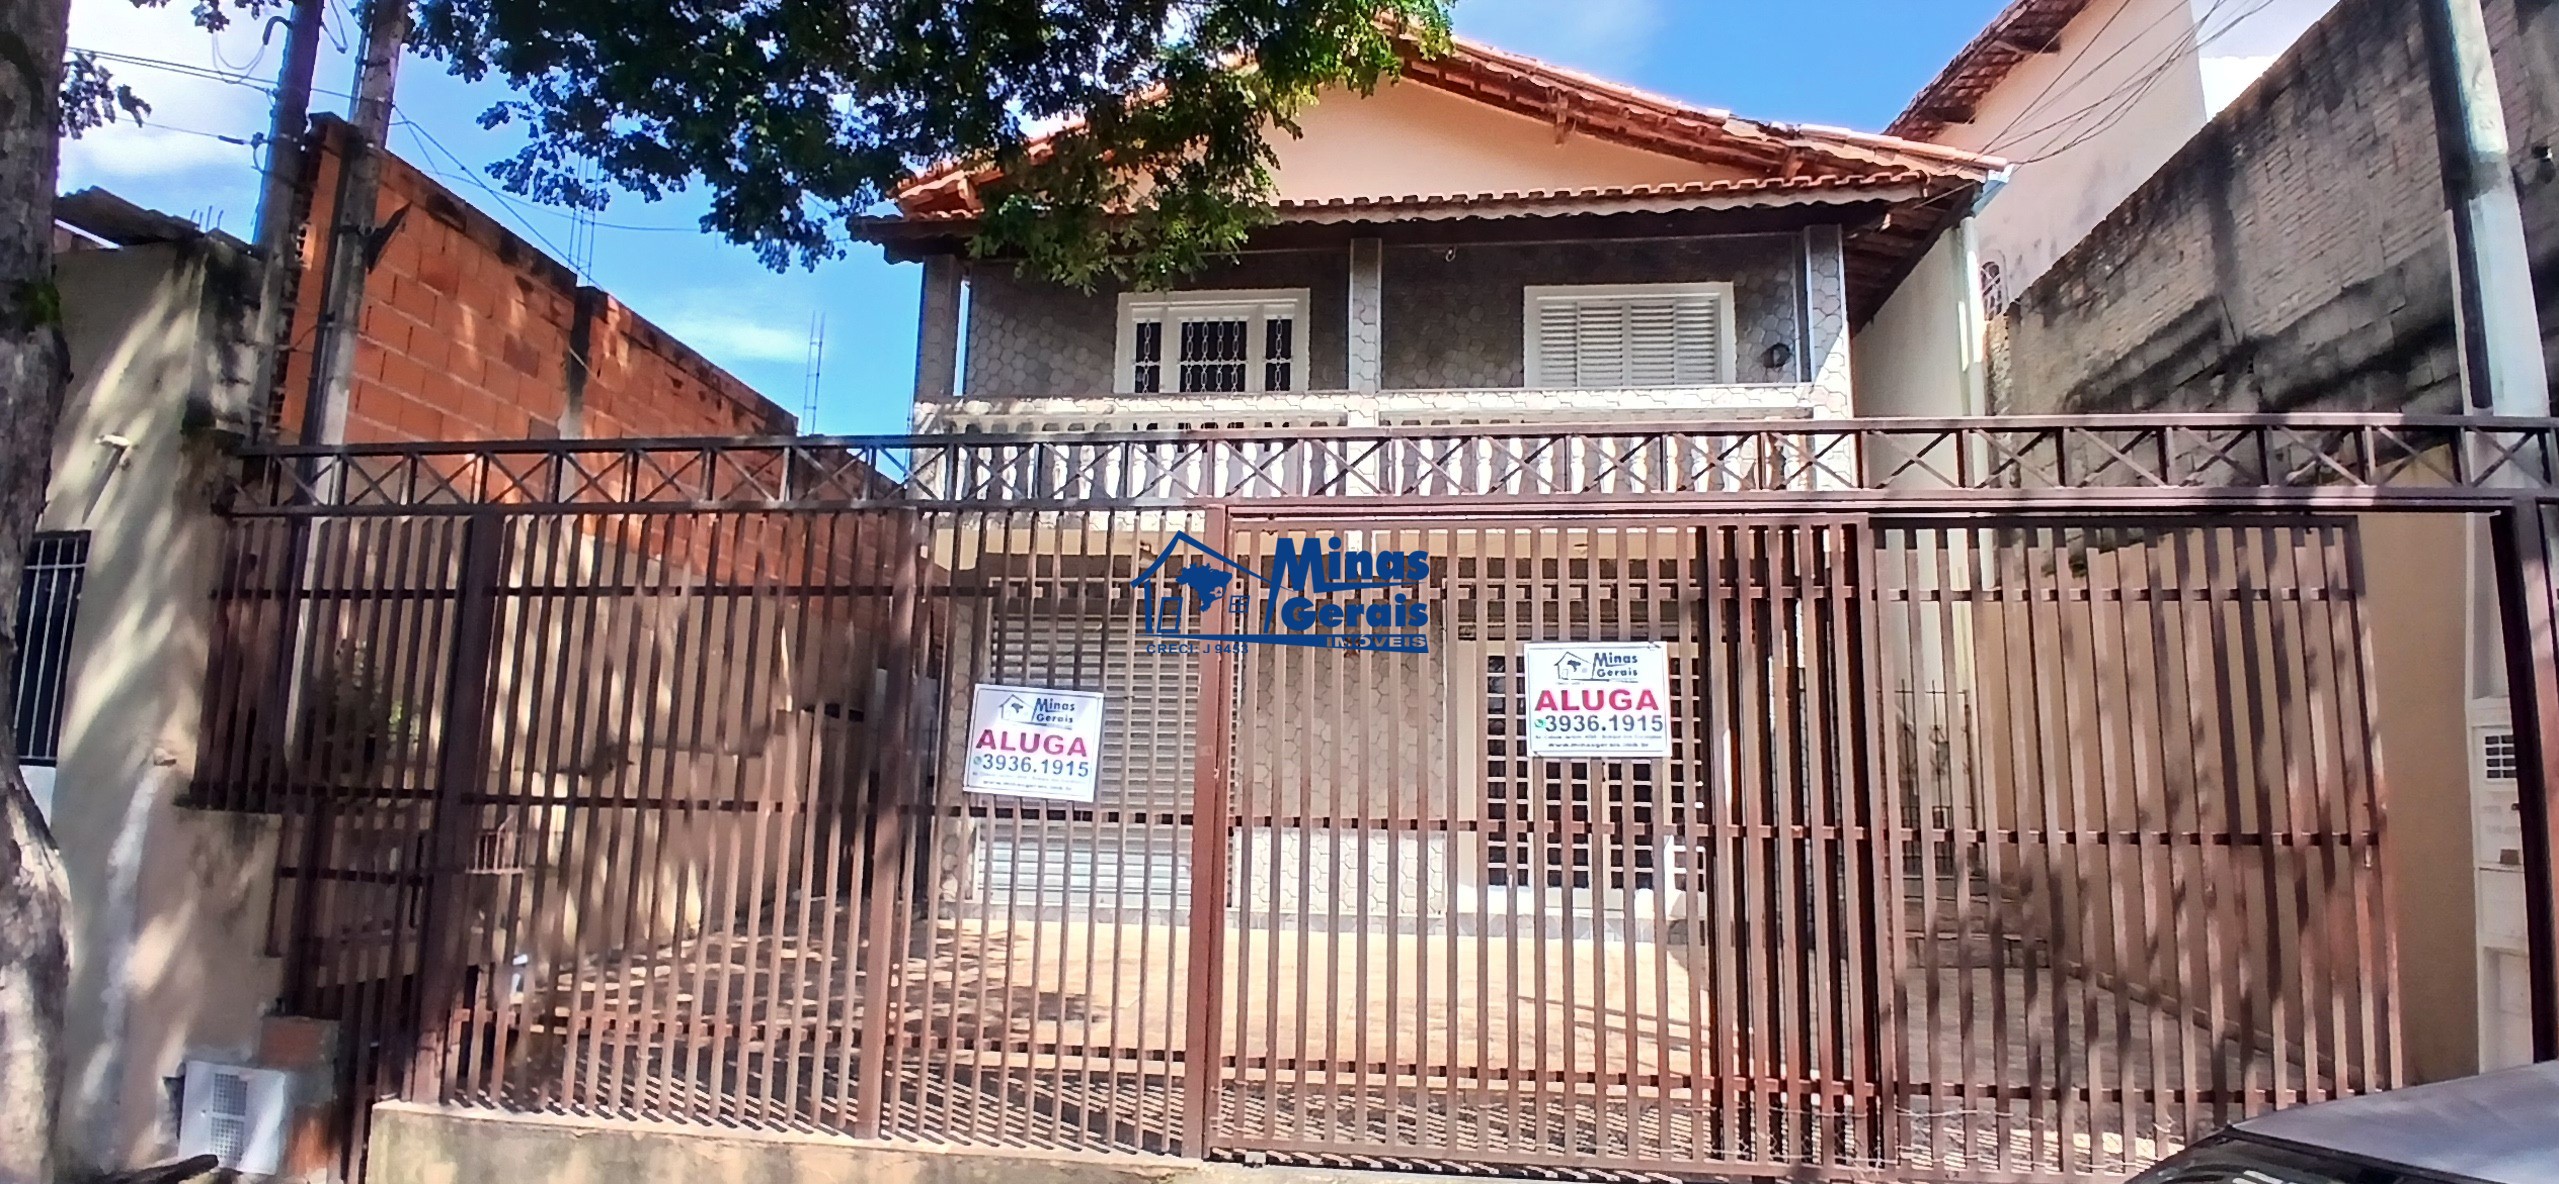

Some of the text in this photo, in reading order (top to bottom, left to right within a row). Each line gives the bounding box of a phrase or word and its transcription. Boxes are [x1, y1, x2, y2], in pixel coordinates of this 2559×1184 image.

[1592, 652, 1638, 668] Minas
[1596, 668, 1638, 678] Gerais
[1032, 698, 1075, 715] Minas
[1534, 689, 1659, 711] ALUGA
[1036, 713, 1074, 724] Gerais
[1545, 714, 1663, 732] 3936.1915
[976, 729, 1087, 757] ALUGA
[982, 753, 1089, 778] 3936.1915
